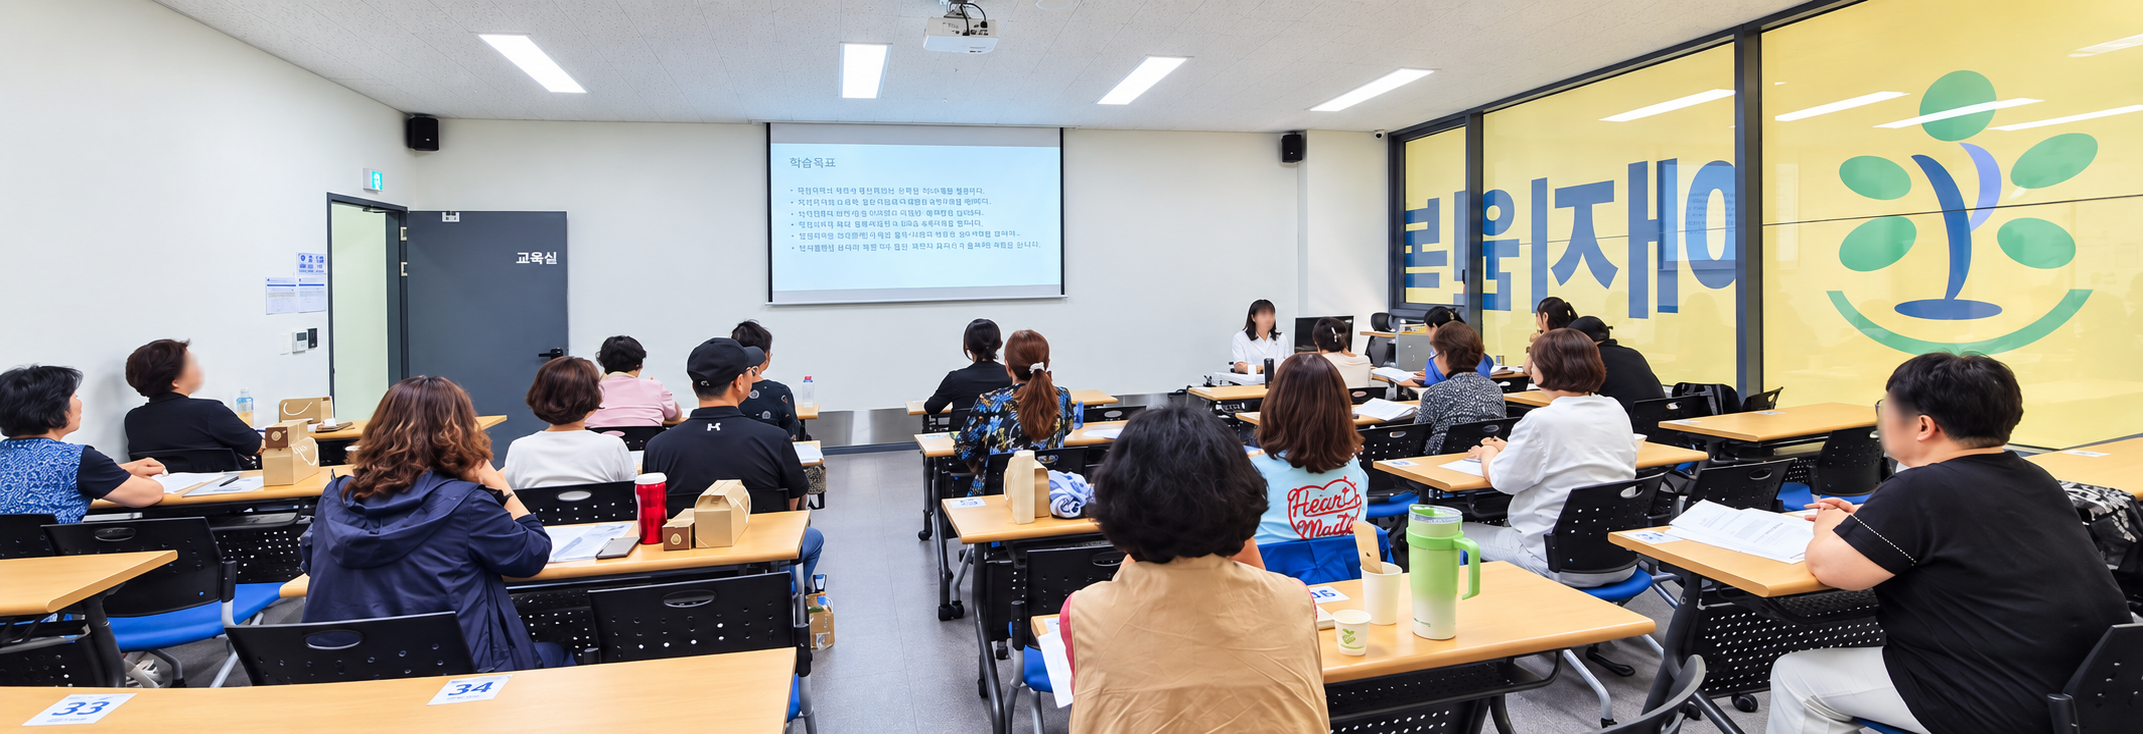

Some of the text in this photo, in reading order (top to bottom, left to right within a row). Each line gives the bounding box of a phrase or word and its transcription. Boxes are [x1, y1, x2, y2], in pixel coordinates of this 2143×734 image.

[789, 157, 836, 168] 학습목표
[516, 251, 557, 265] 교육실
[1288, 486, 1352, 517] Heart
[448, 681, 494, 696] 34
[51, 701, 110, 716] 33
